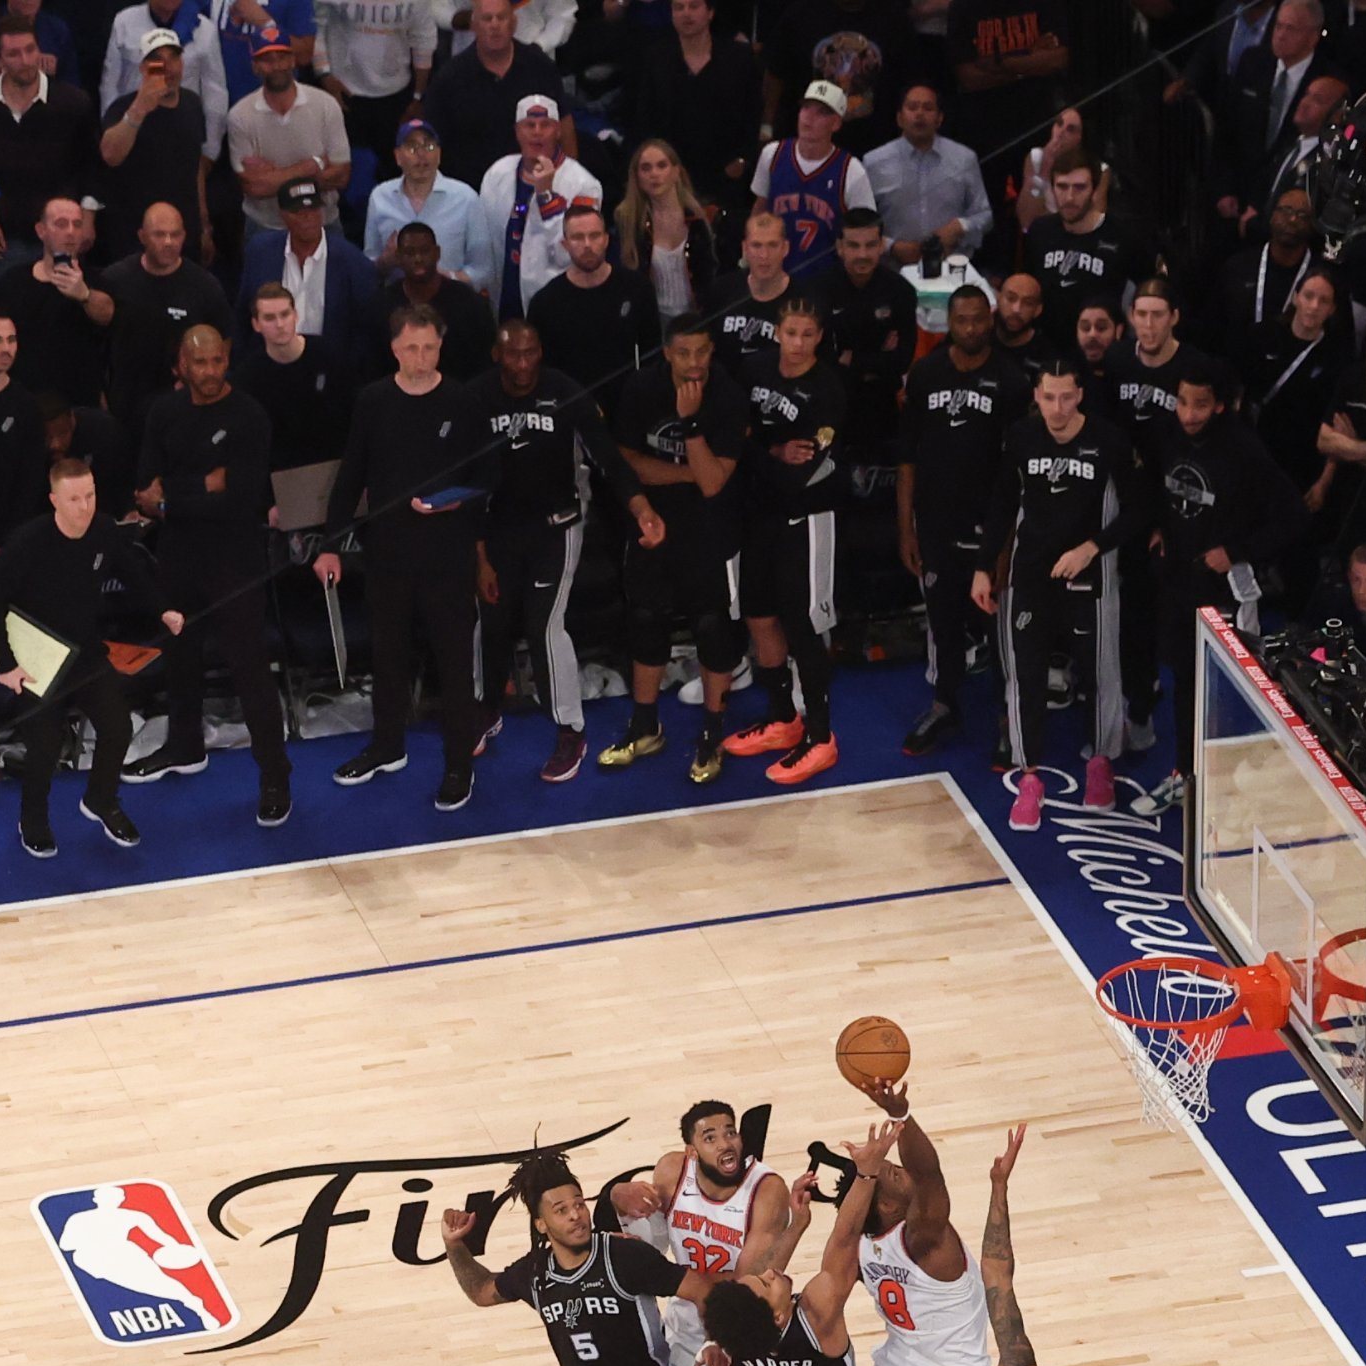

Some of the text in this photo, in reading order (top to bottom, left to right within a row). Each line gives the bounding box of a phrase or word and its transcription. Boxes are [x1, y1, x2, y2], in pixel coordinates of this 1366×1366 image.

[795, 219, 818, 251] 7
[1044, 249, 1104, 276] SPURS
[928, 389, 993, 415] SPURS
[1027, 457, 1095, 483] SPURS
[671, 1209, 744, 1250] NEW YORK
[682, 1237, 731, 1275] 32
[109, 1302, 185, 1338] NBA
[542, 1297, 620, 1330] SPURS
[878, 1278, 916, 1331] 8
[570, 1331, 600, 1361] 5
